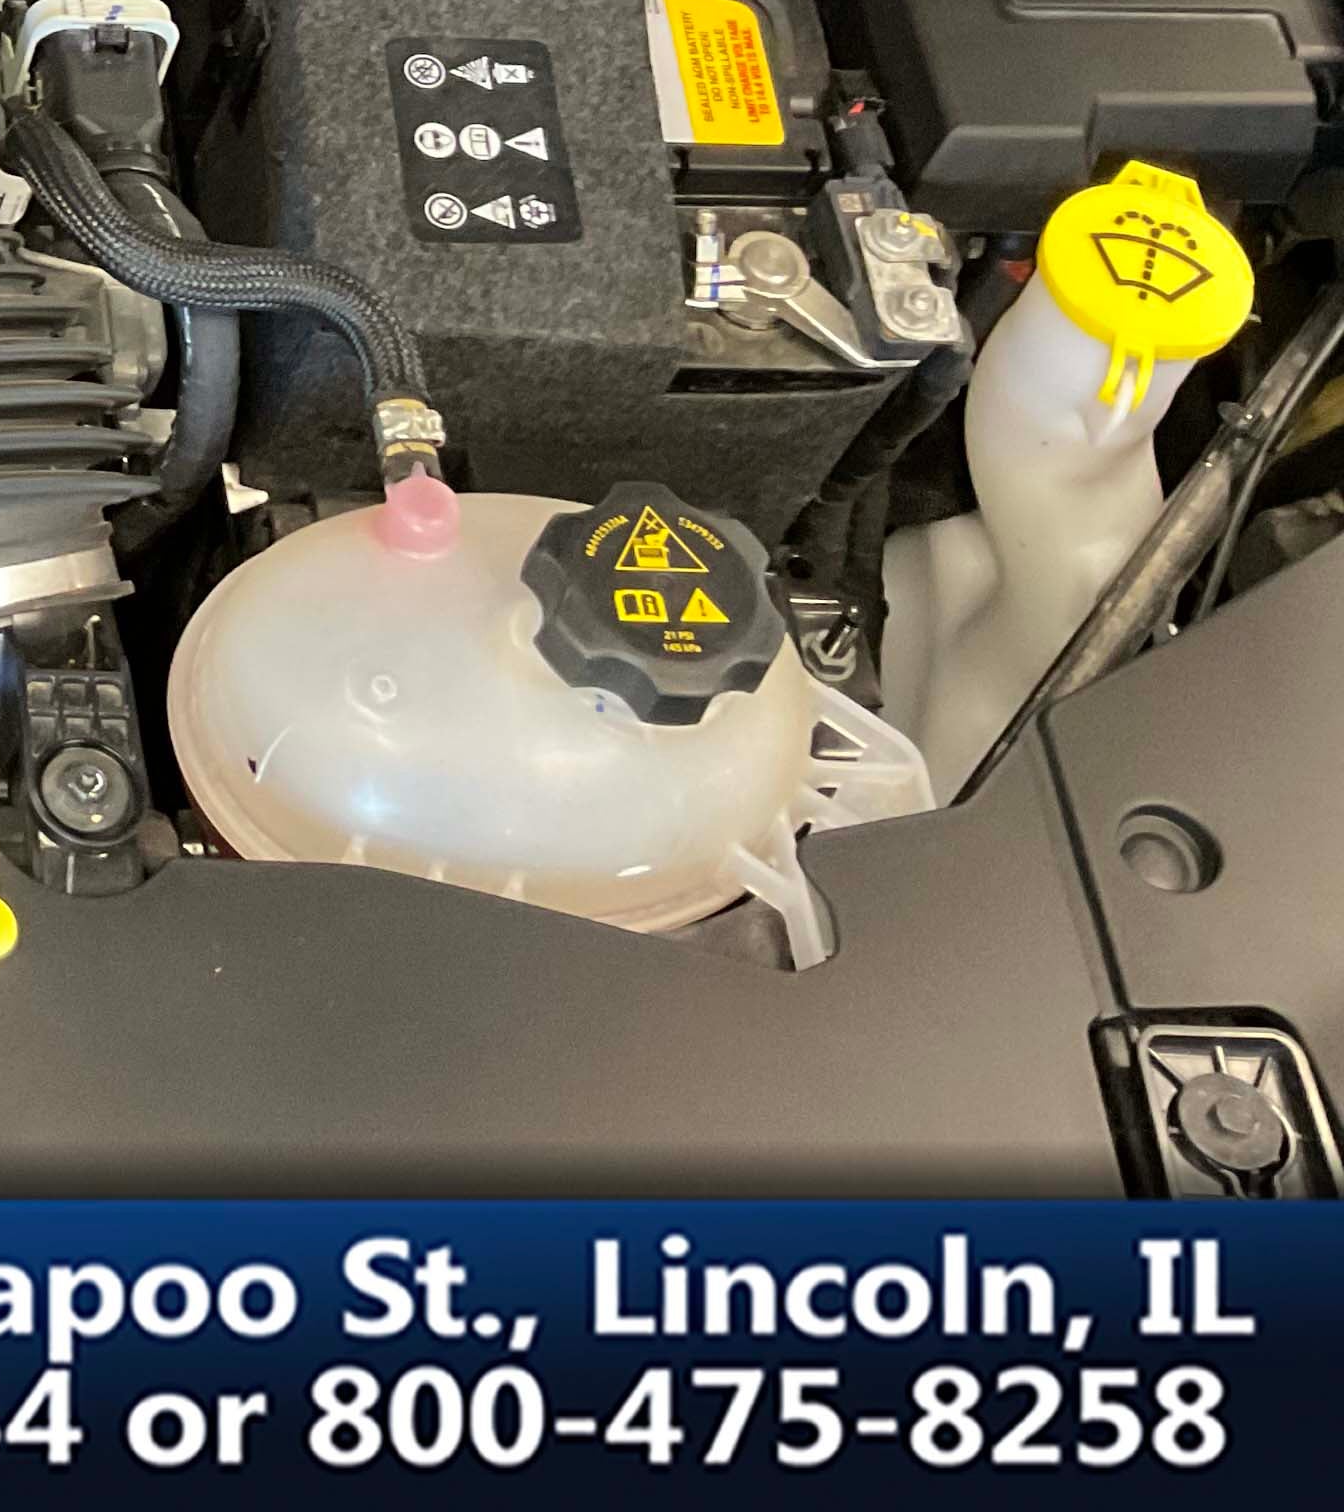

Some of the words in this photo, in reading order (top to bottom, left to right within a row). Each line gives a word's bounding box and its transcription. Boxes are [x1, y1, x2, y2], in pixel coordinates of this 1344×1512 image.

[680, 10, 698, 54] BATTERY
[690, 58, 704, 79] AGM
[706, 65, 718, 84] NOT
[713, 28, 741, 109] NON-SPILLABLE
[735, 62, 752, 96] CHARGE
[695, 82, 714, 122] SEALED
[712, 88, 723, 102] DO
[744, 99, 760, 123] LIMIT
